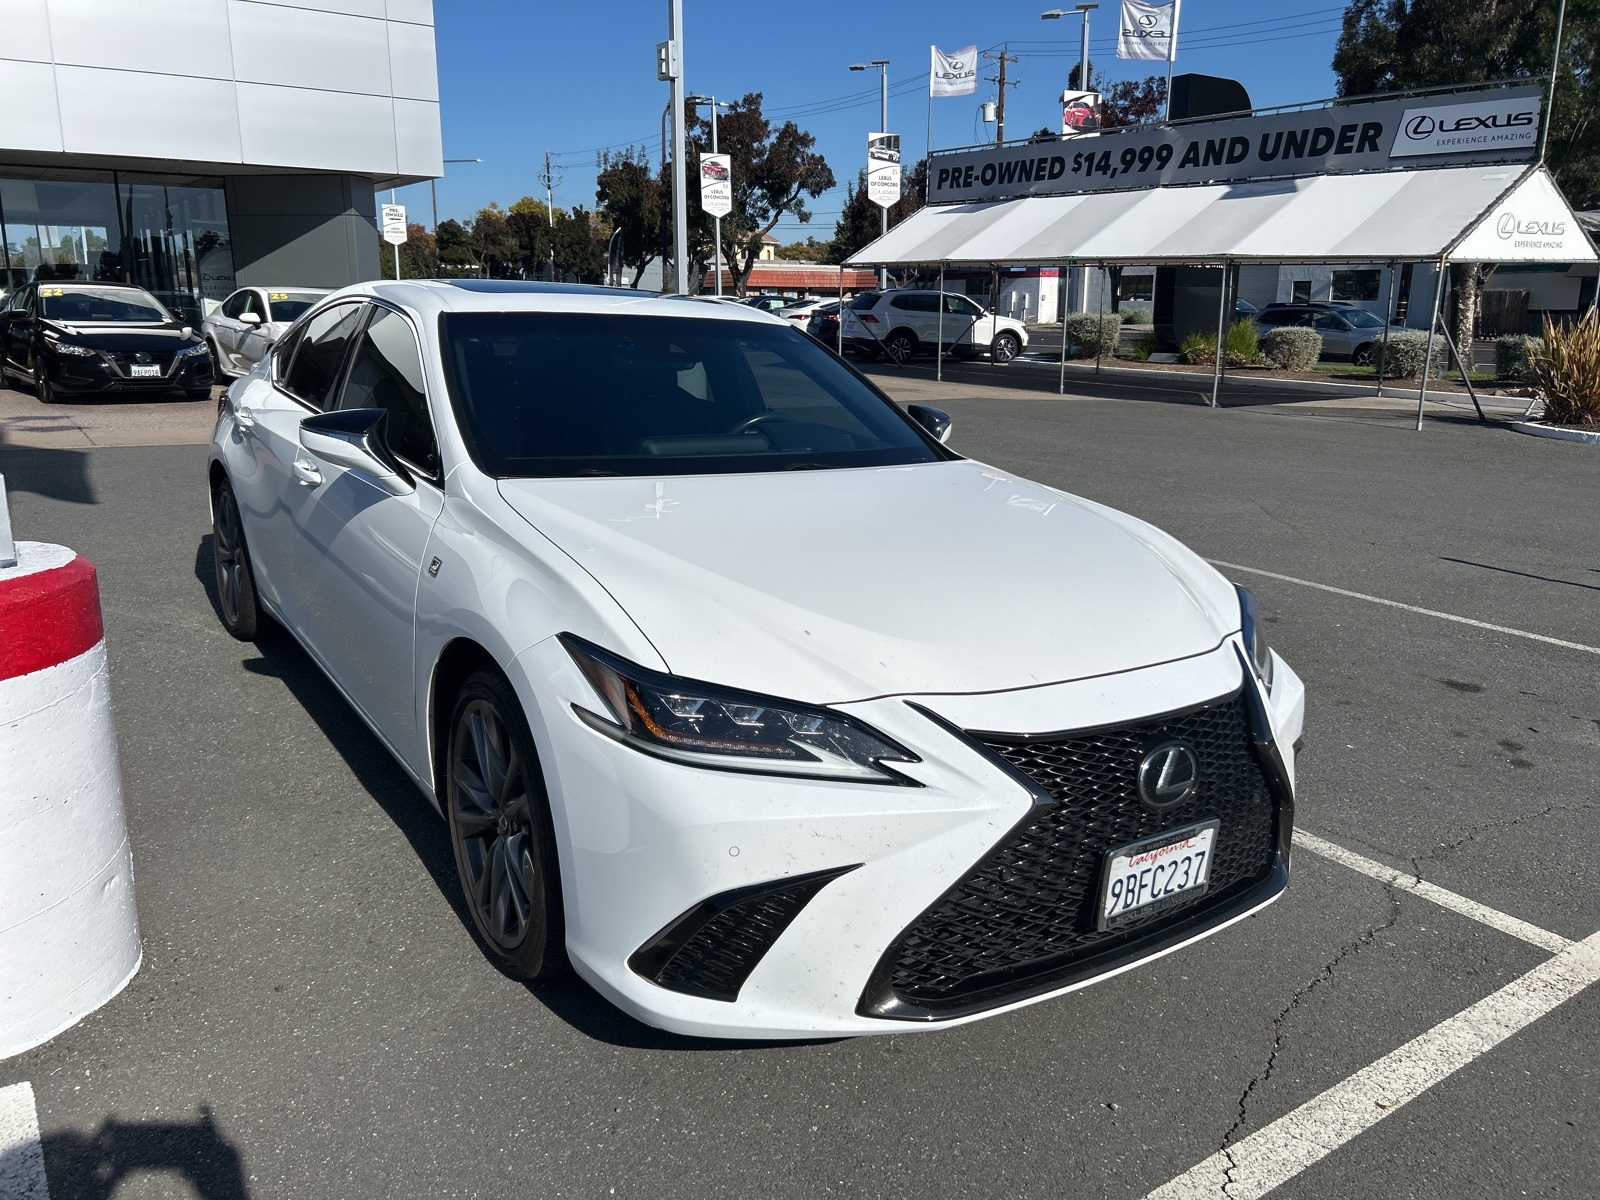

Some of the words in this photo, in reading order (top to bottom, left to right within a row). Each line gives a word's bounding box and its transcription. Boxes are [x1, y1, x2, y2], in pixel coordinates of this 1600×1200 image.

[935, 70, 975, 80] LEXUS
[1438, 112, 1534, 133] LEXUS
[1436, 135, 1488, 146] EXPERIENCE
[1490, 132, 1532, 142] AMAZING
[936, 156, 1066, 190] PRE-OWNED
[1071, 143, 1174, 179] $14,999
[1177, 136, 1250, 169] AND
[1257, 121, 1383, 162] UNDER
[1516, 220, 1566, 236] LEXUS
[1514, 240, 1542, 248] EXPERIENCE
[1542, 241, 1563, 249] AMAZING
[42, 288, 63, 297] 22
[1129, 839, 1196, 867] California
[1107, 850, 1206, 915] 9BFC237
